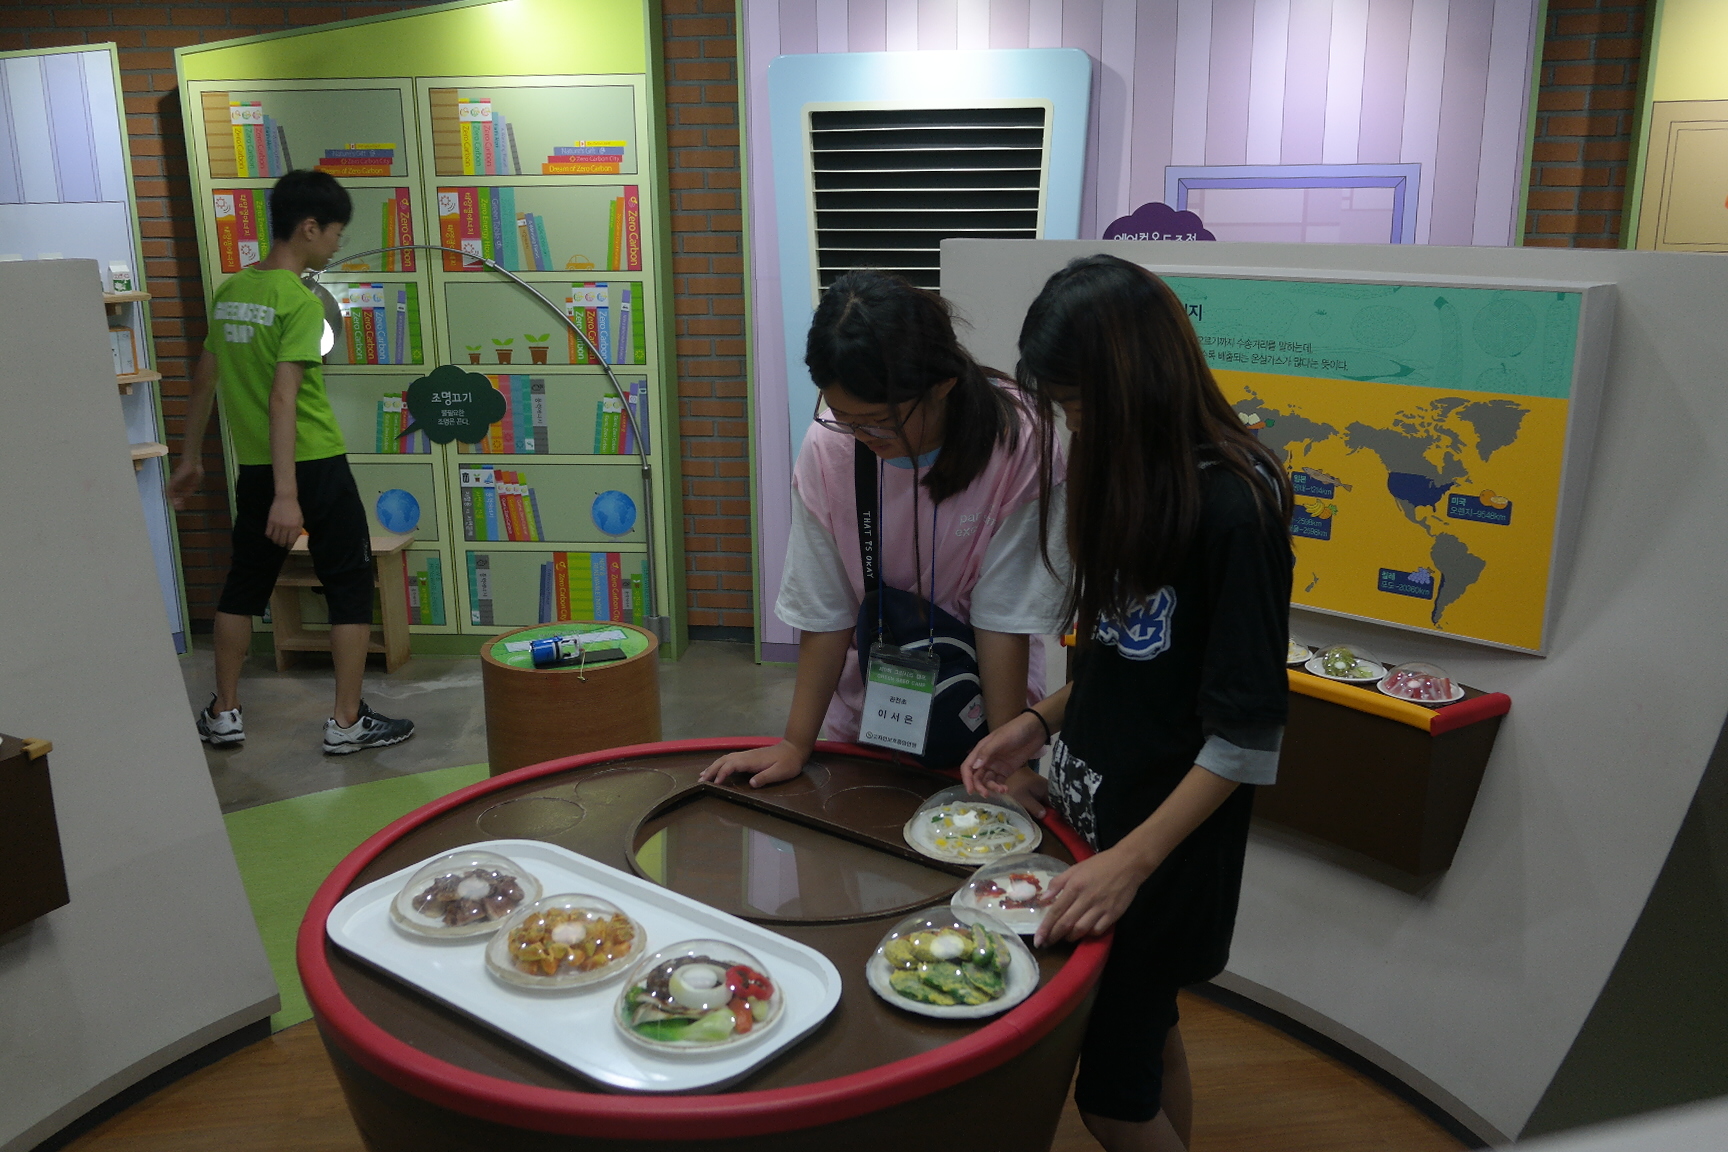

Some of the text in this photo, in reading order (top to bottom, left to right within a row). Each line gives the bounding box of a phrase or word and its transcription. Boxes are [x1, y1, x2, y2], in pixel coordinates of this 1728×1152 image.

[234, 128, 242, 144] Zero
[474, 142, 482, 167] Carbon
[256, 200, 264, 217] Zero
[480, 198, 488, 214] Zero
[258, 218, 266, 242] Energy
[400, 211, 410, 233] Zero
[628, 210, 639, 266] Zero Carbon
[352, 312, 361, 330] Zero
[586, 311, 596, 329] Zero
[599, 311, 607, 329] Zero
[355, 331, 364, 360] Carbon
[364, 312, 374, 359] Zero Carbon
[376, 312, 386, 359] Zero Carbon
[431, 391, 472, 406] 조명끄기
[1451, 497, 1467, 507] 미국
[863, 510, 872, 536] THAT
[865, 555, 874, 578] OKAY
[558, 573, 568, 620] Zero Carbon City
[612, 610, 620, 621] City
